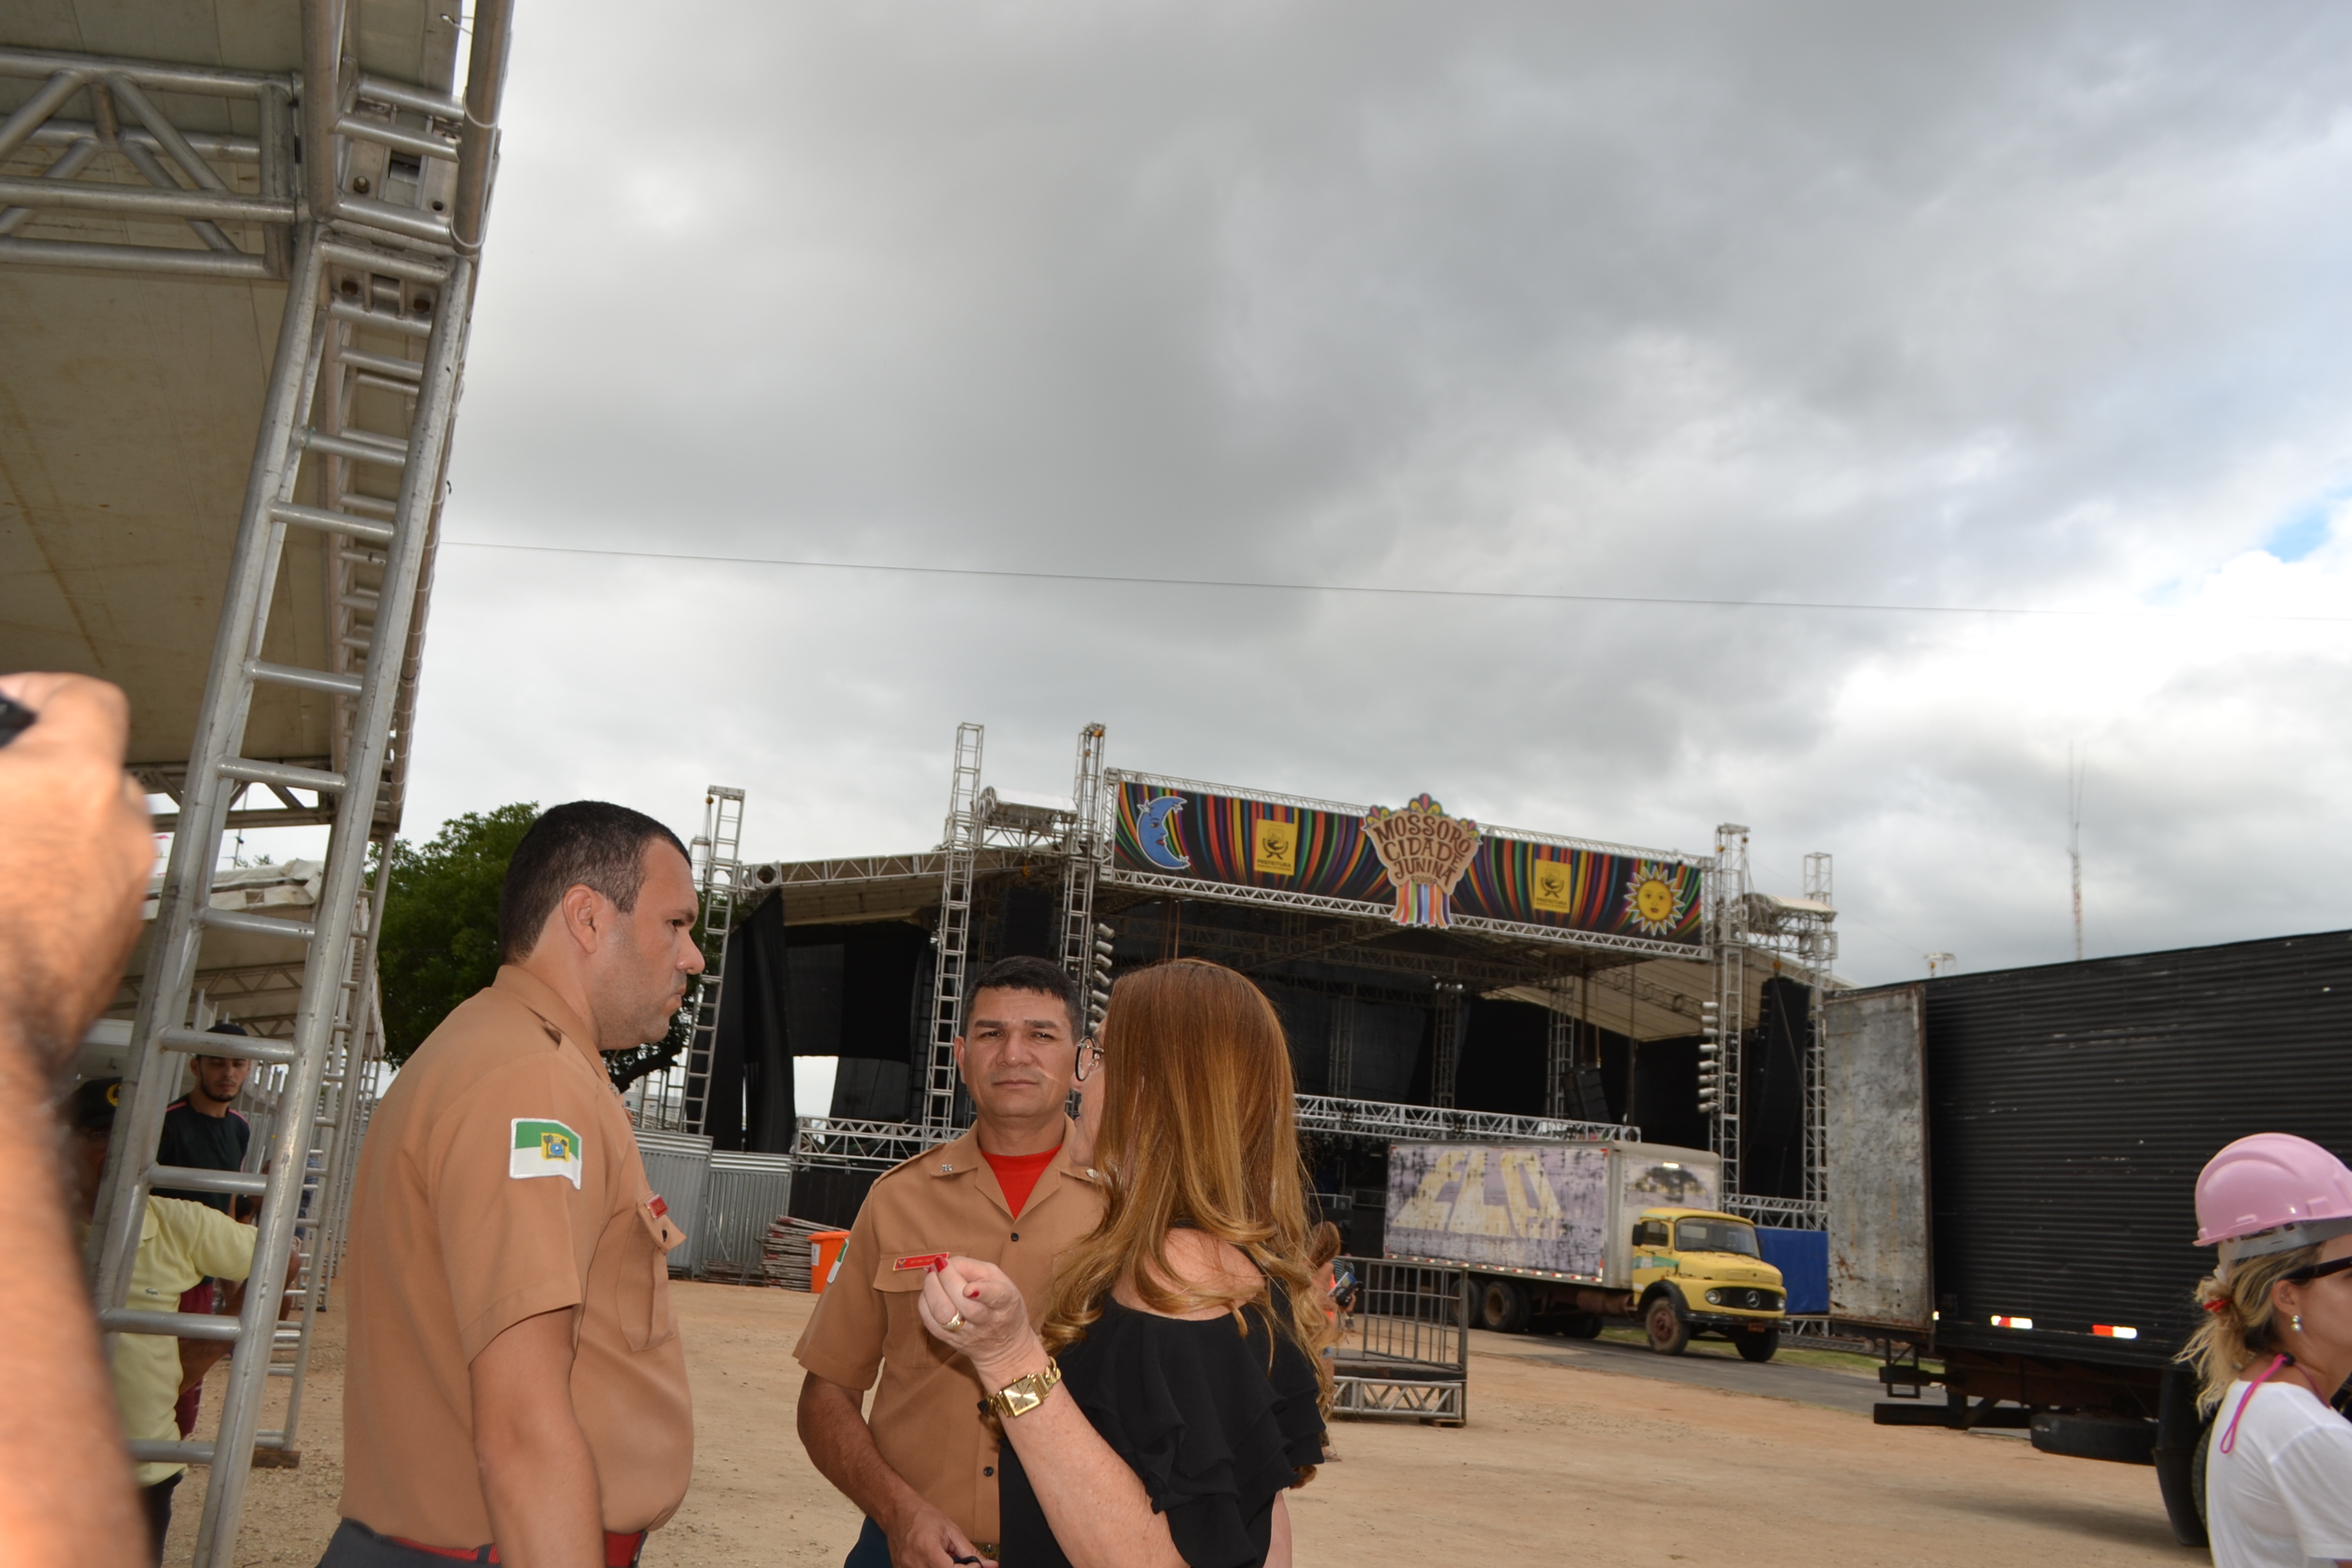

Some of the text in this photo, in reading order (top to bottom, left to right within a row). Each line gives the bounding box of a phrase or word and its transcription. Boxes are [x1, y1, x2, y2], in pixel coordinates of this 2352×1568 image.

[1373, 814, 1471, 858] MOSSORÓ
[1257, 859, 1291, 867] PREFEITURA
[1383, 836, 1463, 870] CIDADE
[1393, 857, 1457, 887] JUNINA
[1416, 875, 1433, 884] 2019
